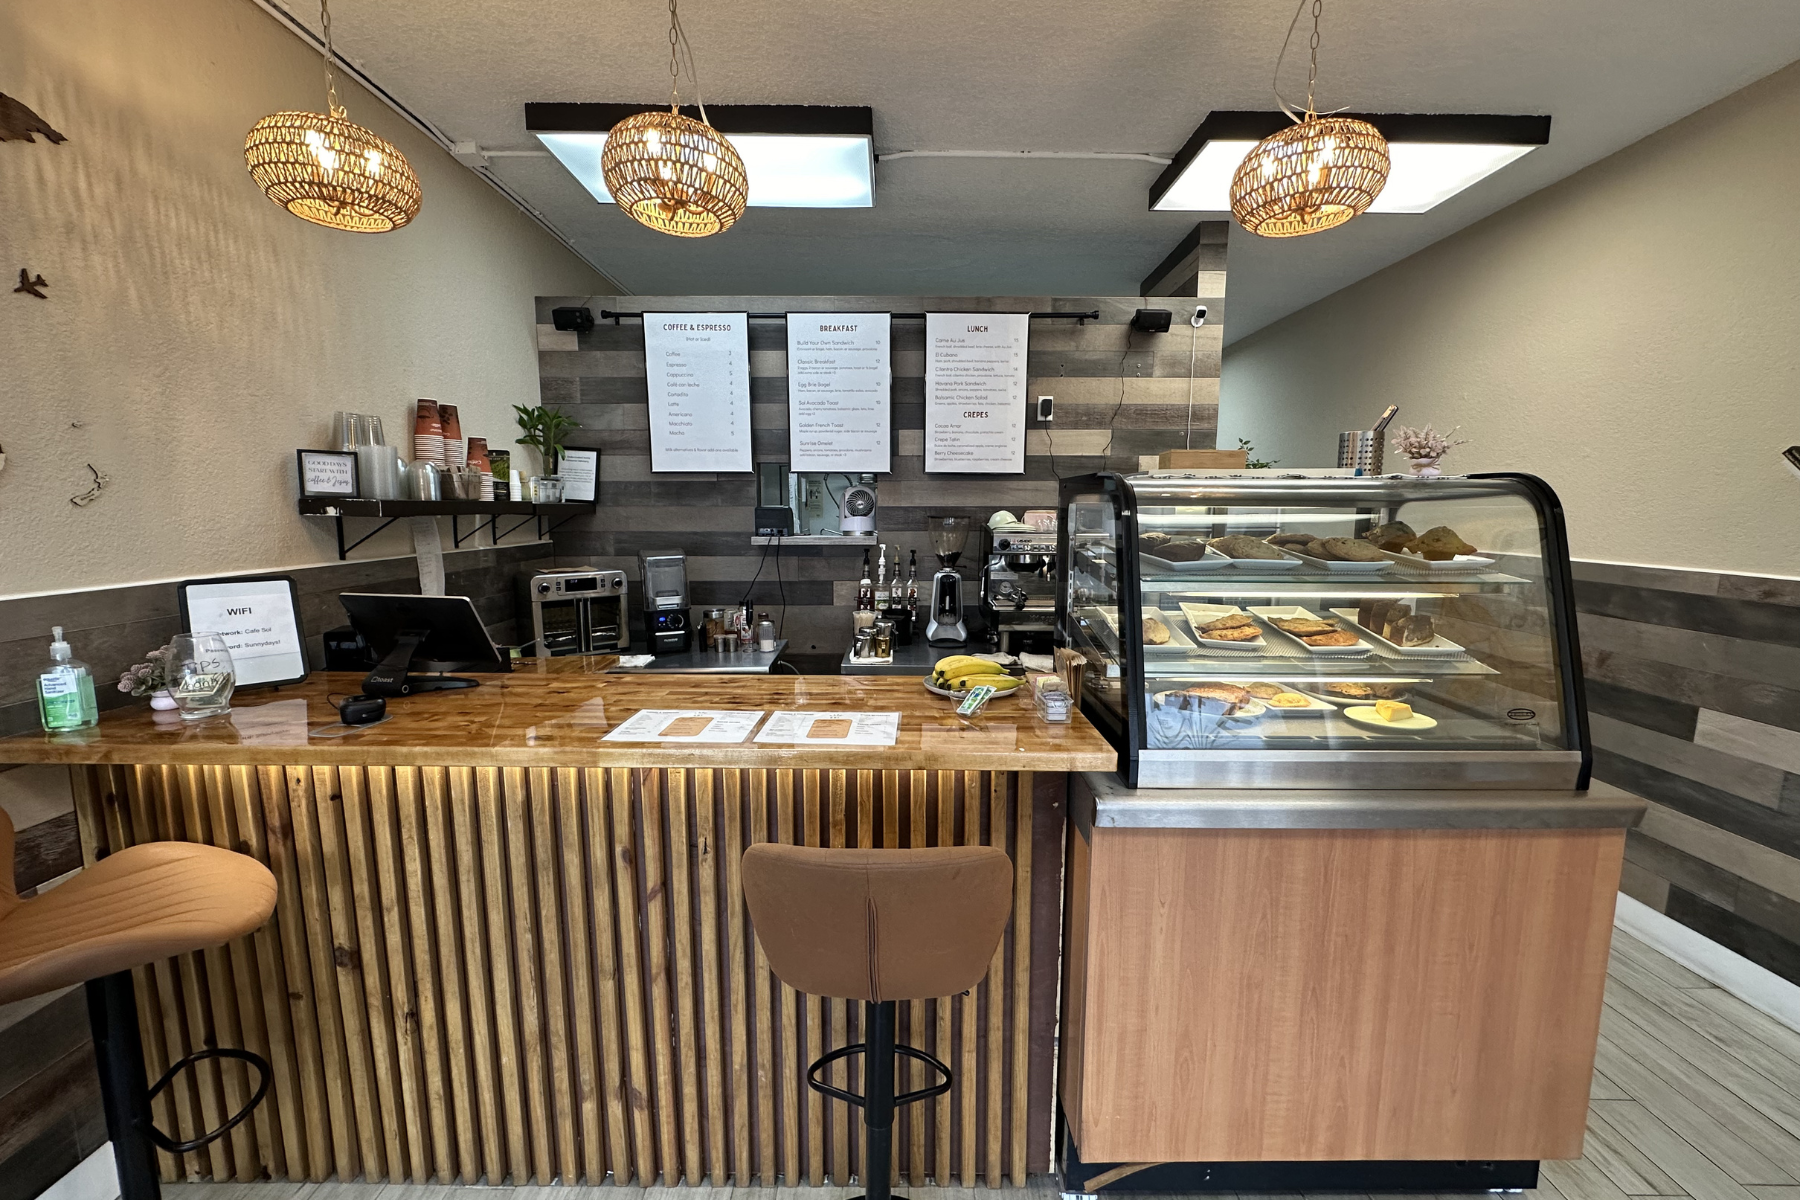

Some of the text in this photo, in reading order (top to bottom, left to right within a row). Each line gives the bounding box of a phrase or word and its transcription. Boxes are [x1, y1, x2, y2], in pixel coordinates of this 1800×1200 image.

[307, 475, 325, 485] coffee
[332, 476, 350, 487] Jesus
[226, 607, 252, 616] WIFI
[244, 640, 281, 649] Sunnydays!
